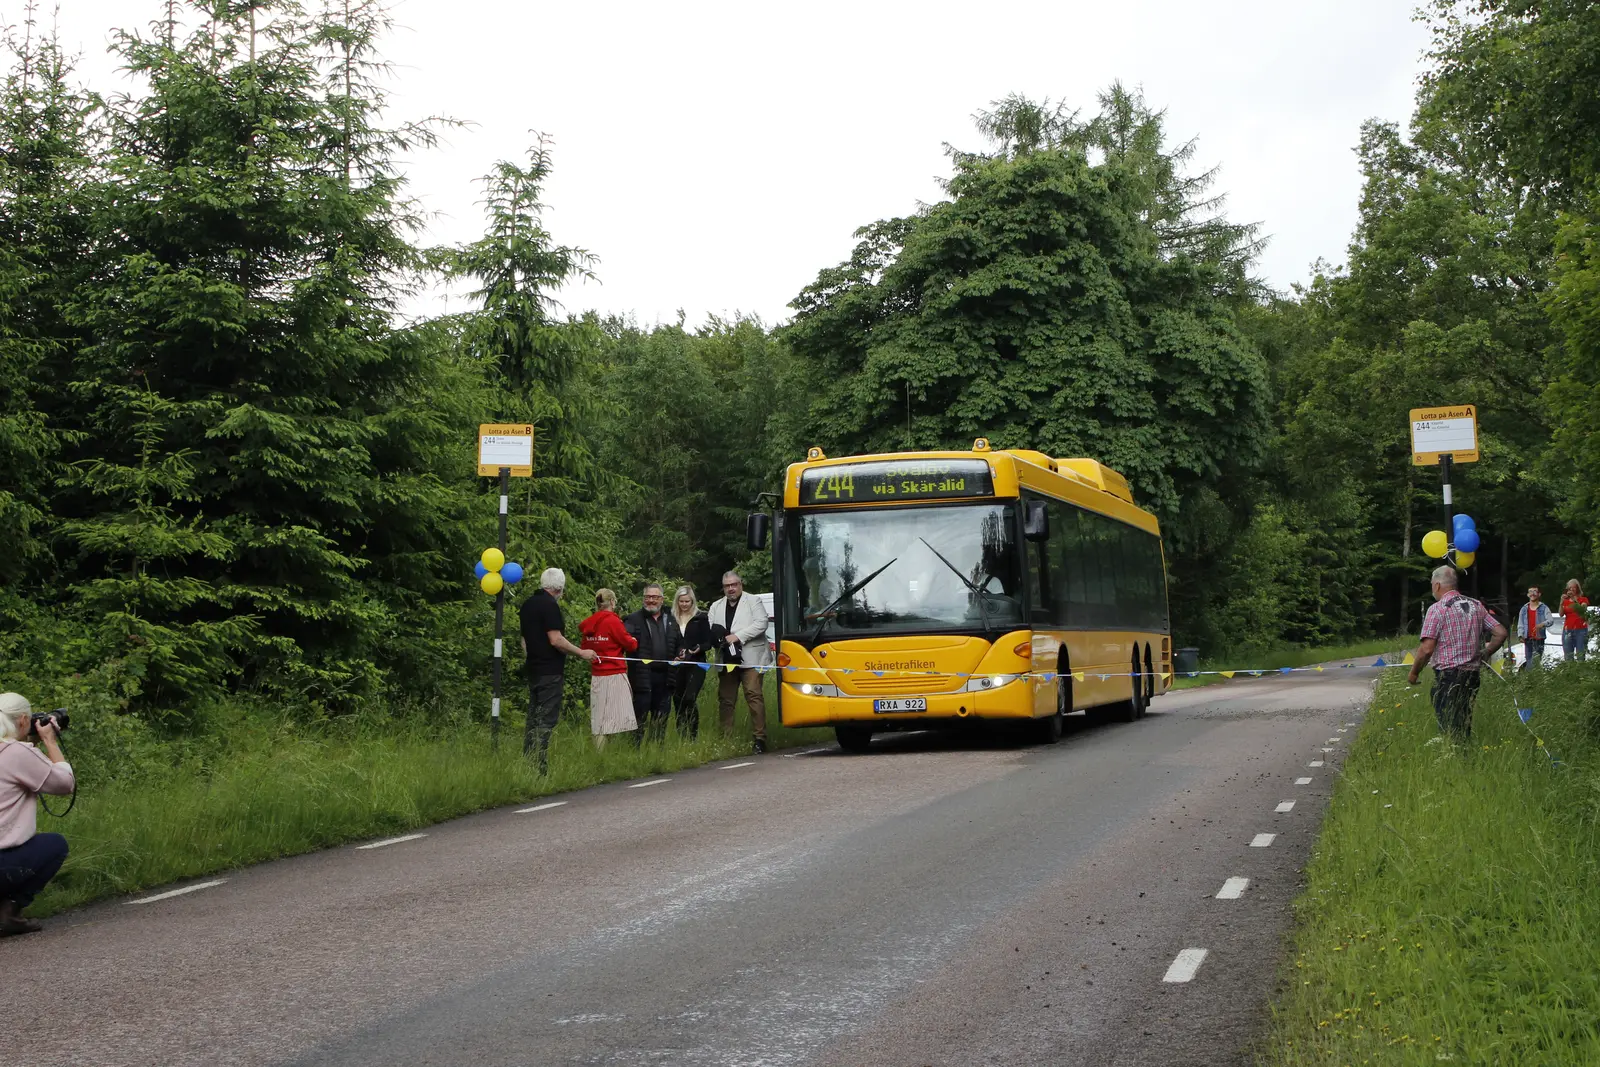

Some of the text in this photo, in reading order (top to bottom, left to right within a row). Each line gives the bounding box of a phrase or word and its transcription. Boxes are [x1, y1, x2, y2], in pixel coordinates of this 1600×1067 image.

[1420, 412, 1437, 420] Lotta
[525, 426, 532, 435] B
[1416, 421, 1430, 431] 244
[483, 436, 496, 445] 244
[872, 478, 965, 495] via Skäralid
[864, 659, 936, 671] Skånetrafiken
[879, 699, 924, 710] RXA 922
